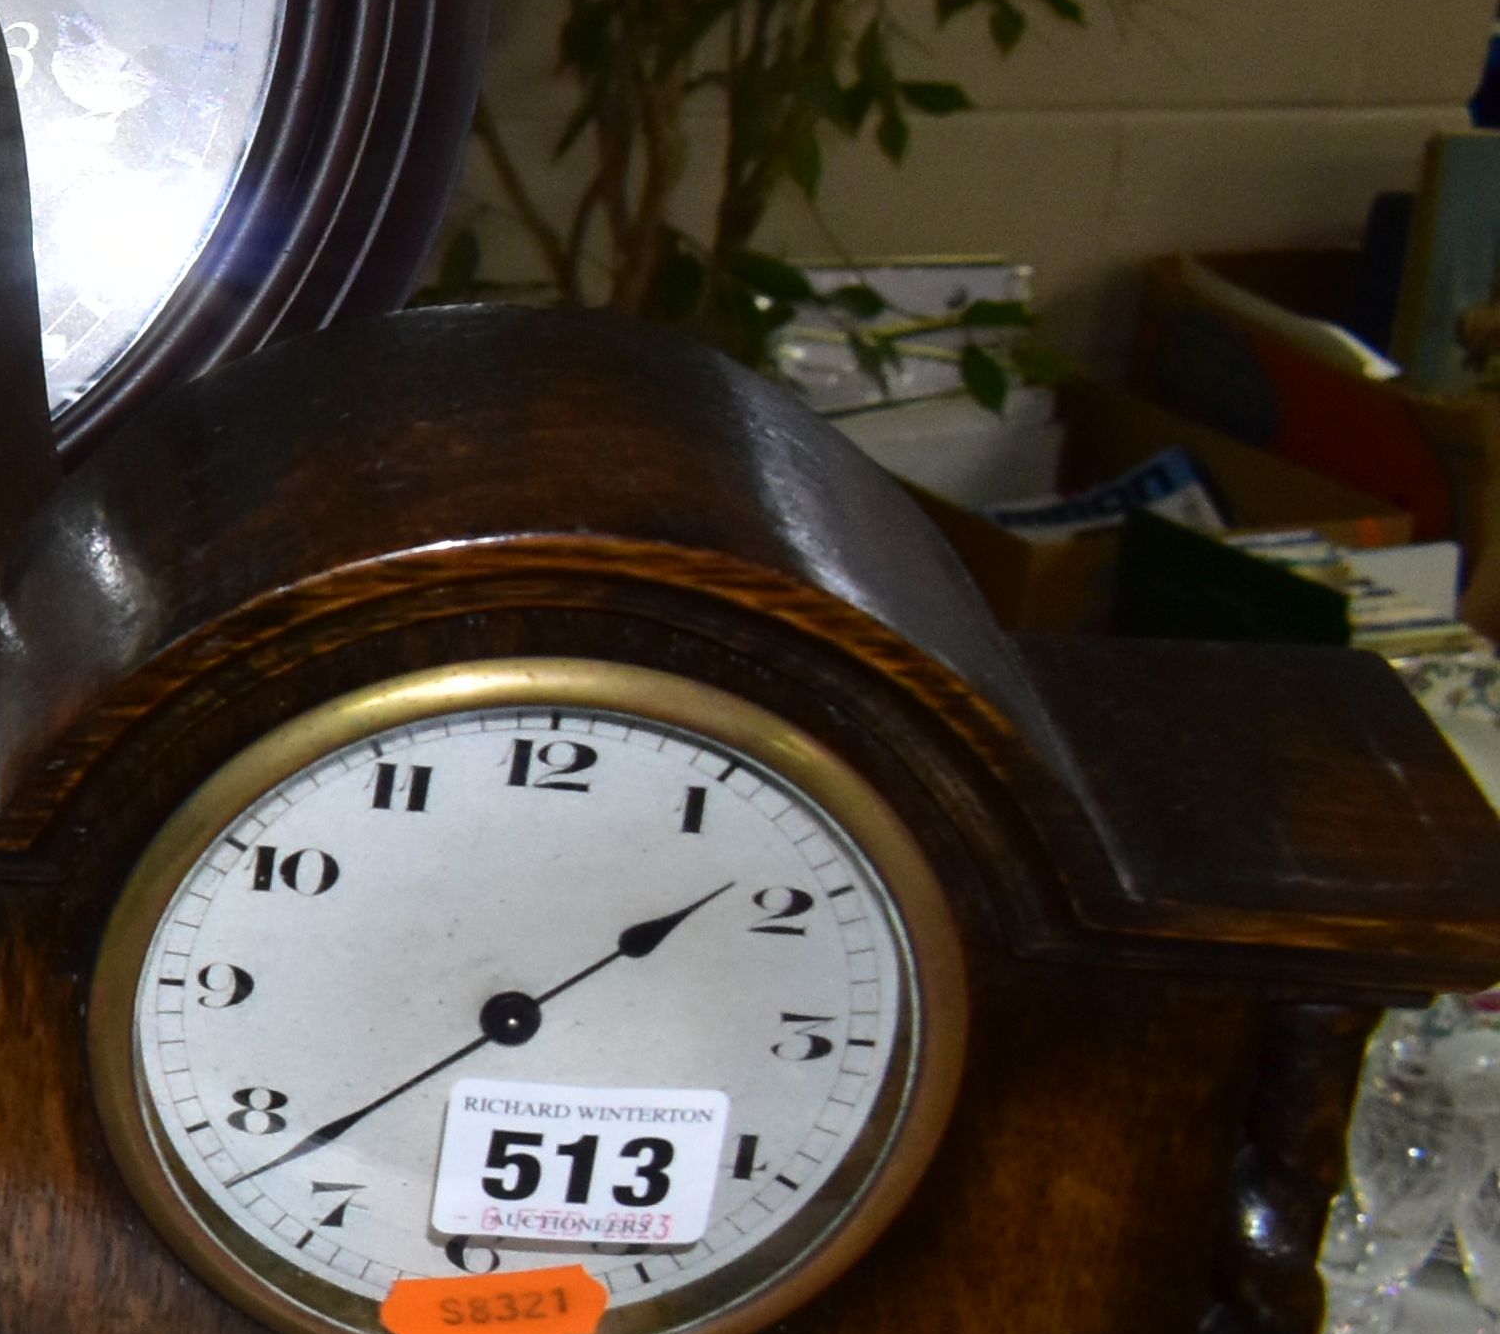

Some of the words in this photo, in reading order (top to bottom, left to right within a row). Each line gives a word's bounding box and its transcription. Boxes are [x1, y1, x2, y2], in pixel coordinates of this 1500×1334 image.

[370, 762, 433, 814] 11
[504, 738, 599, 794] 12
[681, 785, 708, 834] 1
[250, 845, 341, 898] 10
[748, 885, 815, 937] 2
[196, 962, 255, 1008] 9
[771, 1012, 837, 1063] 3
[226, 1086, 290, 1135] 8
[463, 1095, 572, 1121] RICHARD
[577, 1105, 715, 1124] WINTERTON
[481, 1128, 675, 1208] 513
[311, 1182, 368, 1227] 7
[494, 1213, 652, 1235] AUCTIONEERS
[439, 1287, 570, 1327] S8321
